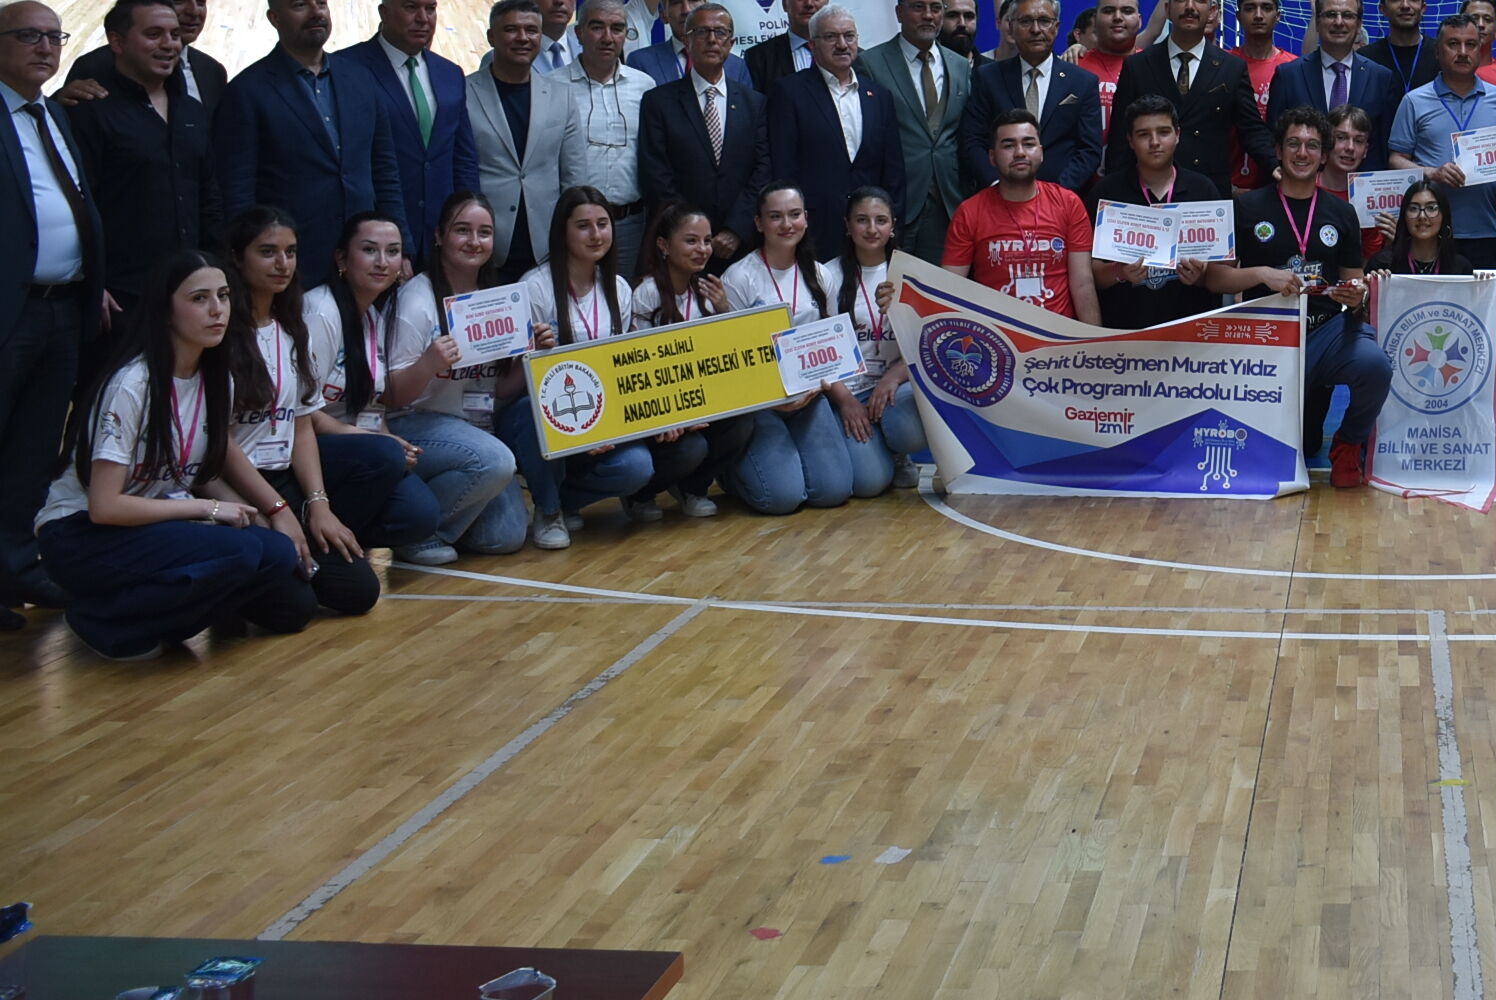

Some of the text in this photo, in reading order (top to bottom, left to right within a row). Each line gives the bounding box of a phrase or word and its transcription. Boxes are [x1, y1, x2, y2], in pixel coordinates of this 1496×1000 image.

[612, 347, 650, 368] MANİSA
[657, 336, 694, 356] SALİHLİ
[1401, 311, 1426, 332] BİLİM
[1442, 309, 1475, 328] SANAT
[1472, 329, 1485, 376] MERKEZİ
[617, 346, 777, 395] HAFSA SULTAN MESLEKİ VE TEK
[1024, 351, 1277, 377] Şehit Üsteğmen Murat Yıldız
[624, 384, 706, 423] ANADOLU LİSESİ
[1022, 377, 1282, 404] Çok Programlı Anadolu Lisesi
[1425, 399, 1449, 409] 2004
[1407, 424, 1462, 438] MANİSA
[1378, 441, 1491, 455] BİLİM VE SANAT
[1401, 457, 1466, 471] MERKEZİ
